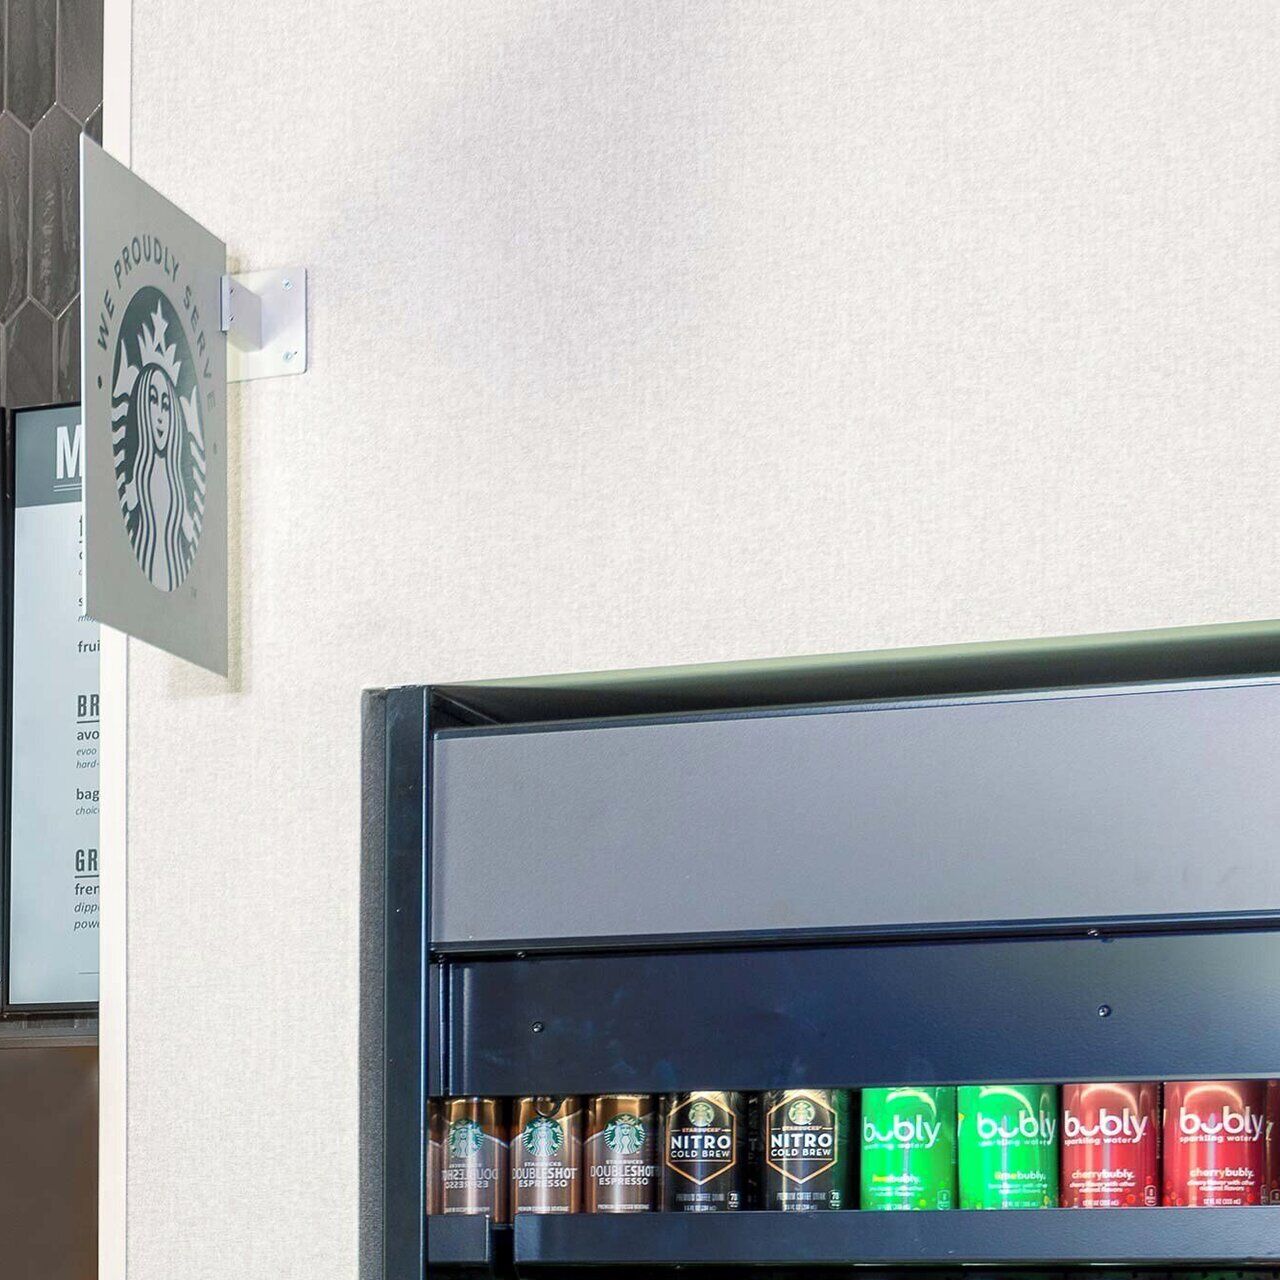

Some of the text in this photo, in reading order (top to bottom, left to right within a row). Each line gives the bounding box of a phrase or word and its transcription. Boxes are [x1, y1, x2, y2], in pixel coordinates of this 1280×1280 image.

[97, 234, 217, 411] WE PROUDLY SERVE
[671, 1135, 731, 1149] NITRO
[771, 1133, 832, 1148] NITRO
[671, 1150, 730, 1158] COLD BREW
[802, 1148, 832, 1156] BREW
[513, 1168, 577, 1180] DOUBLESHOT
[519, 1180, 567, 1188] ESPRESSO
